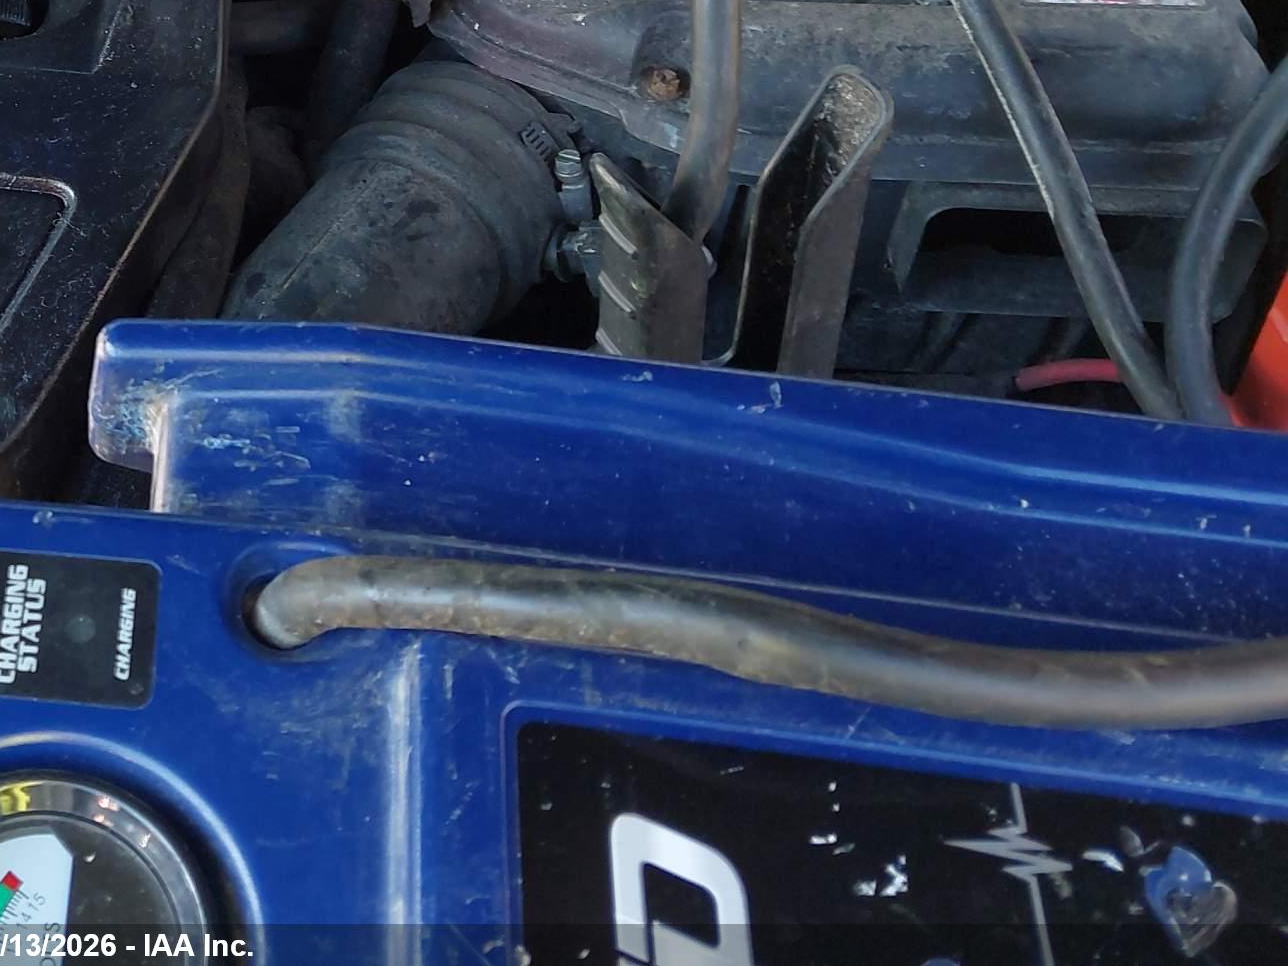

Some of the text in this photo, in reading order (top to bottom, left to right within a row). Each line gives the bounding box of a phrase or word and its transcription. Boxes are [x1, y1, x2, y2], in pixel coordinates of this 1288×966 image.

[16, 578, 47, 673] STATUS
[114, 587, 137, 681] CHARGING
[15, 911, 33, 931] 14
[27, 891, 47, 912] 15
